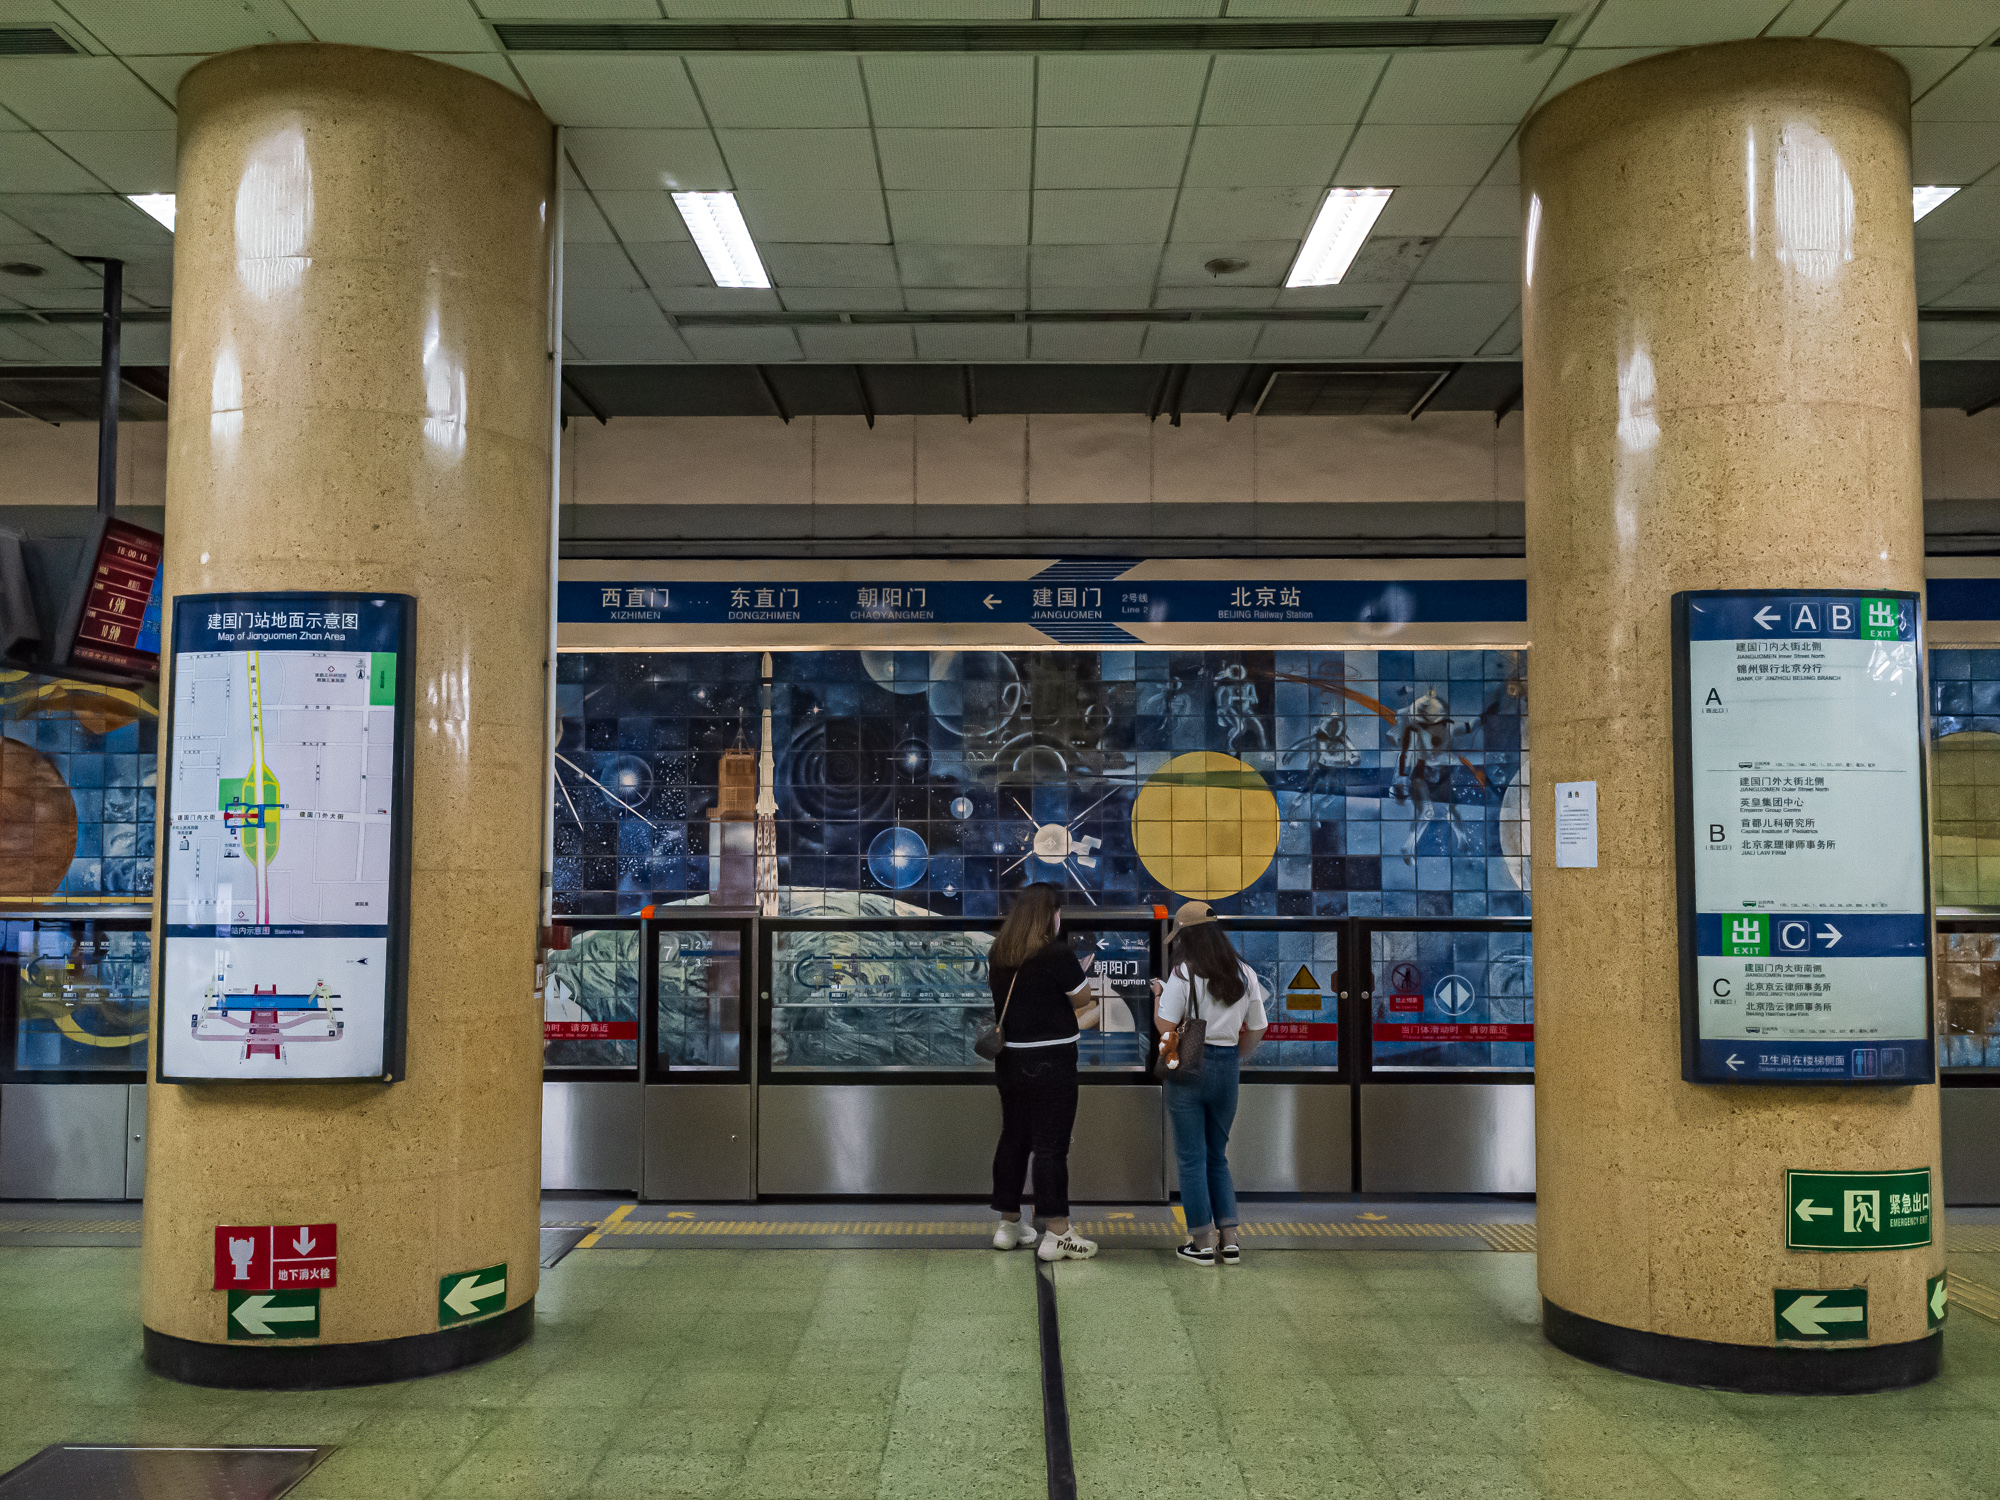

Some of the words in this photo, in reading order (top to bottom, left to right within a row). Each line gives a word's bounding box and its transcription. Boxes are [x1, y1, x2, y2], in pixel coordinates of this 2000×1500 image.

[601, 588, 669, 608] 西直门
[730, 587, 799, 608] 东直门
[857, 587, 926, 608] 朝阳门
[1032, 587, 1102, 608] 建国门
[1122, 593, 1148, 603] 2号线
[1231, 586, 1301, 607] 北京站
[610, 611, 661, 620] XIZHIMEN
[728, 611, 800, 620] DONGZHIMEN
[850, 611, 934, 620] CHAOYANGMEN
[1031, 611, 1102, 620] JIANGUOMEN
[1122, 606, 1140, 614] Line
[1143, 606, 1149, 614] 2
[1218, 610, 1251, 620] BEIJING
[1253, 610, 1283, 620] Railway
[1285, 610, 1313, 620] Station
[1794, 605, 1817, 630] A
[1832, 605, 1852, 630] B
[1869, 601, 1893, 627] 出
[207, 612, 359, 630] 建国门站地面示意图
[217, 632, 234, 642] Map
[237, 632, 245, 640] of
[247, 632, 297, 642] Jianguomen
[300, 632, 322, 640] Zhan
[324, 632, 345, 641] Area
[1736, 641, 1822, 651] 建国门内大街北侧
[1737, 664, 1822, 674] 锦州银行北京分行
[1705, 687, 1722, 705] A
[1740, 776, 1825, 787] 建国门外大街北侧
[1740, 797, 1805, 807] 英皇集团中心
[1741, 818, 1815, 828] 首都儿科研究所
[1709, 824, 1726, 842] B
[1741, 839, 1836, 850] 北京家理律师事务所
[231, 926, 271, 935] 站内示意图
[1732, 918, 1761, 943] 出
[1782, 922, 1806, 949] C
[1124, 938, 1144, 946] 下一站
[1733, 947, 1760, 955] EXIT
[1094, 961, 1138, 975] 朝阳门
[1744, 963, 1822, 972] 建国门内大街南侧
[1713, 978, 1731, 997] C
[1745, 982, 1831, 992] 北京京云律师事务所
[1270, 1025, 1309, 1034] 请勿靠近
[1758, 1055, 1845, 1066] 卫生间在楼梯侧面
[1889, 1192, 1929, 1215] 紧急出口
[1889, 1216, 1919, 1228] EMERGENCY
[1919, 1215, 1928, 1224] EXIT
[1056, 1239, 1083, 1254] PUMA
[278, 1267, 330, 1281] 地下消火栓
